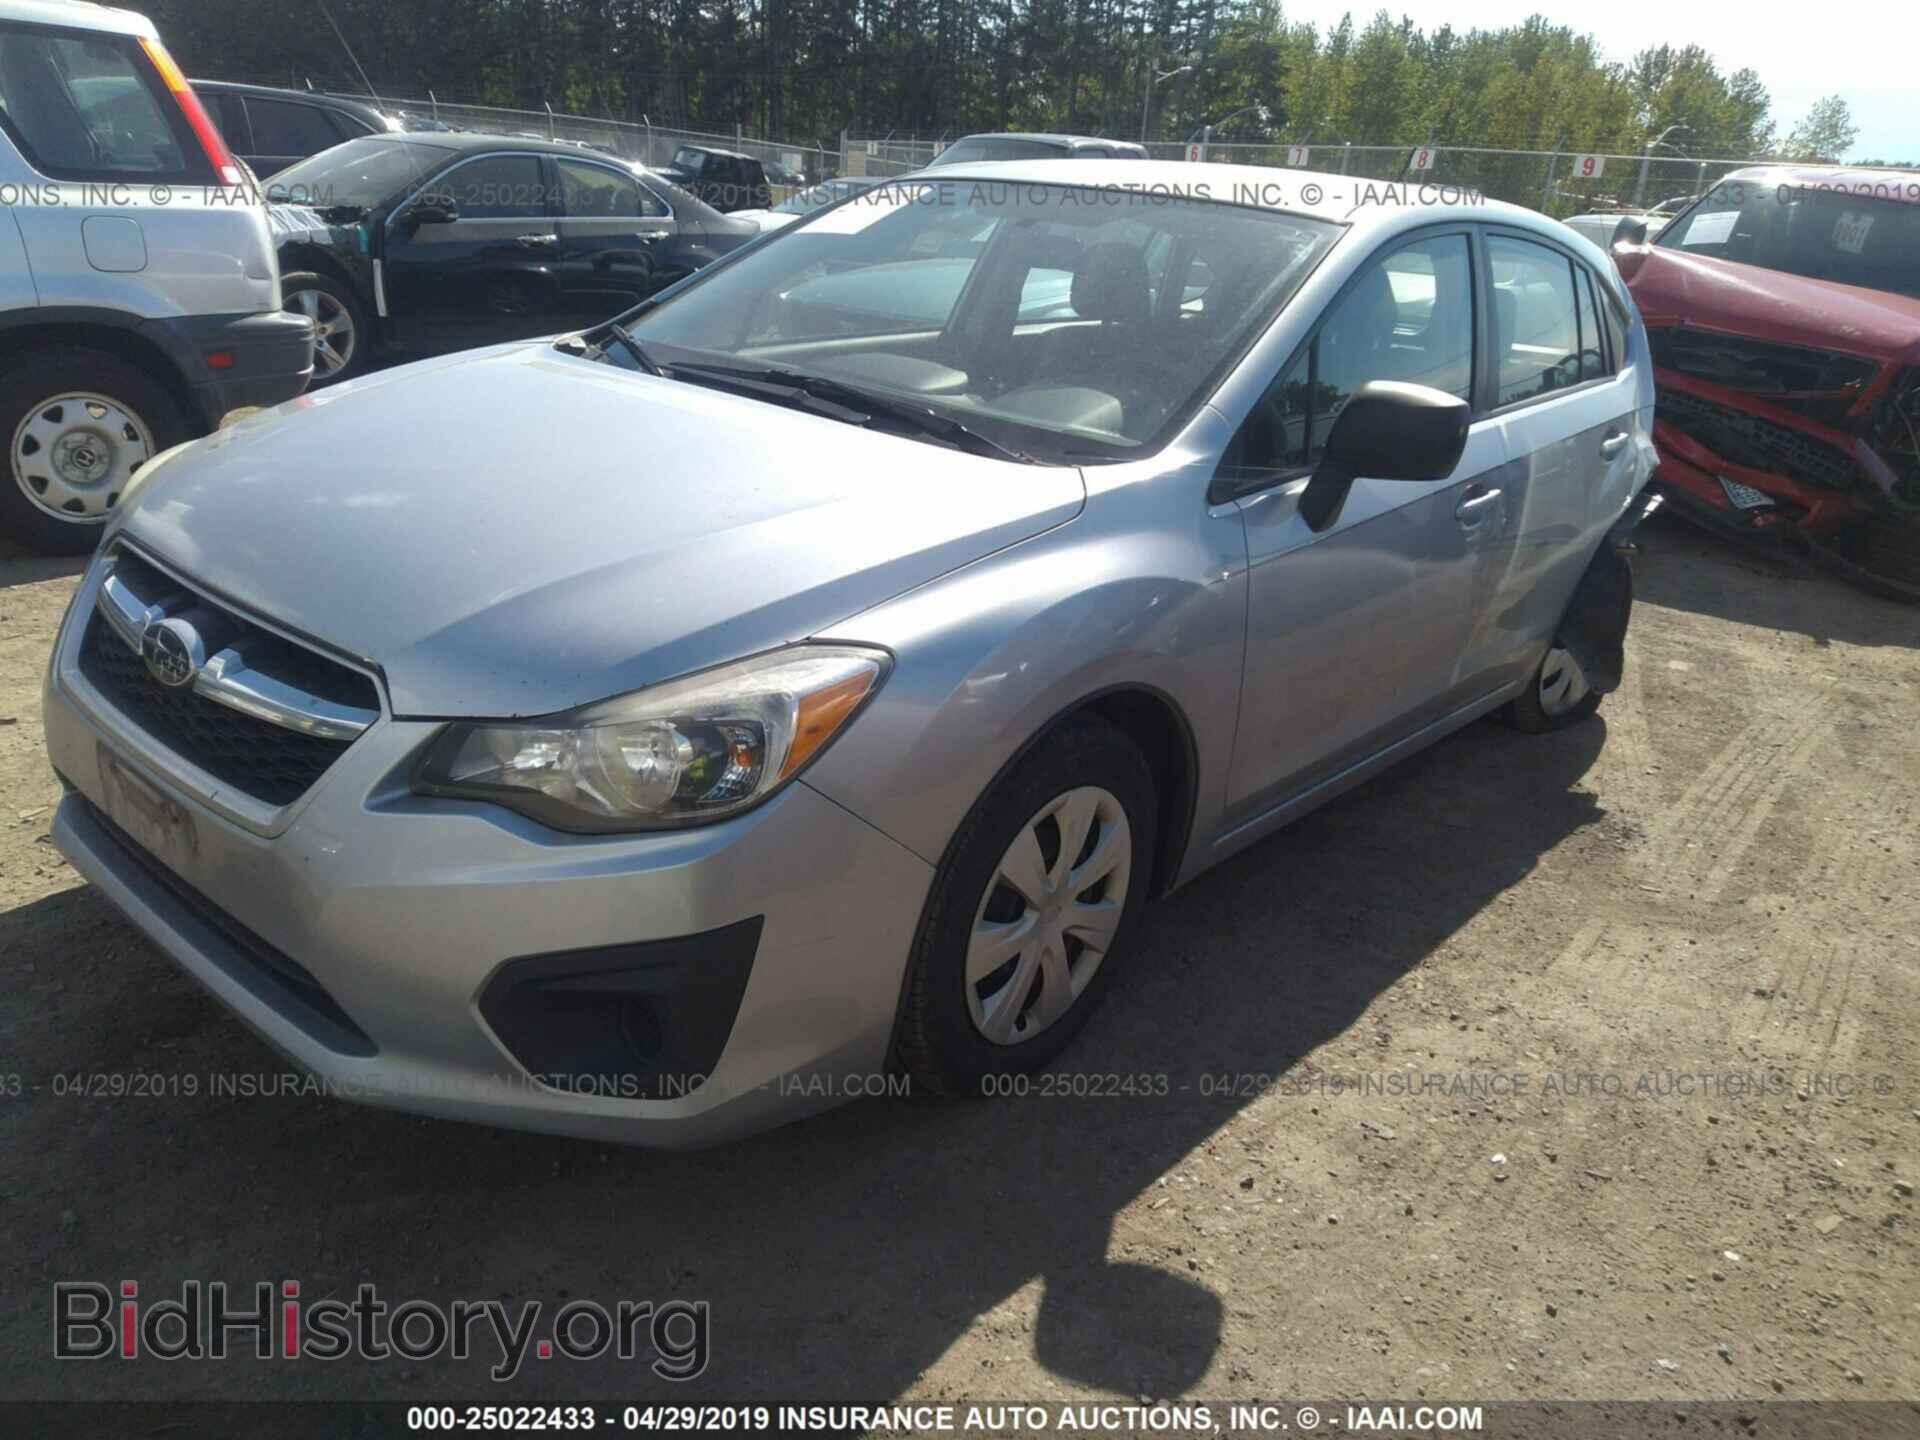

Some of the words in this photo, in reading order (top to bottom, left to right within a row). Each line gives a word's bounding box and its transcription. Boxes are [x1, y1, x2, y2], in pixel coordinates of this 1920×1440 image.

[1191, 144, 1198, 161] 6
[1295, 147, 1303, 165] 7
[1417, 150, 1428, 168] 8
[1582, 157, 1595, 176] 9
